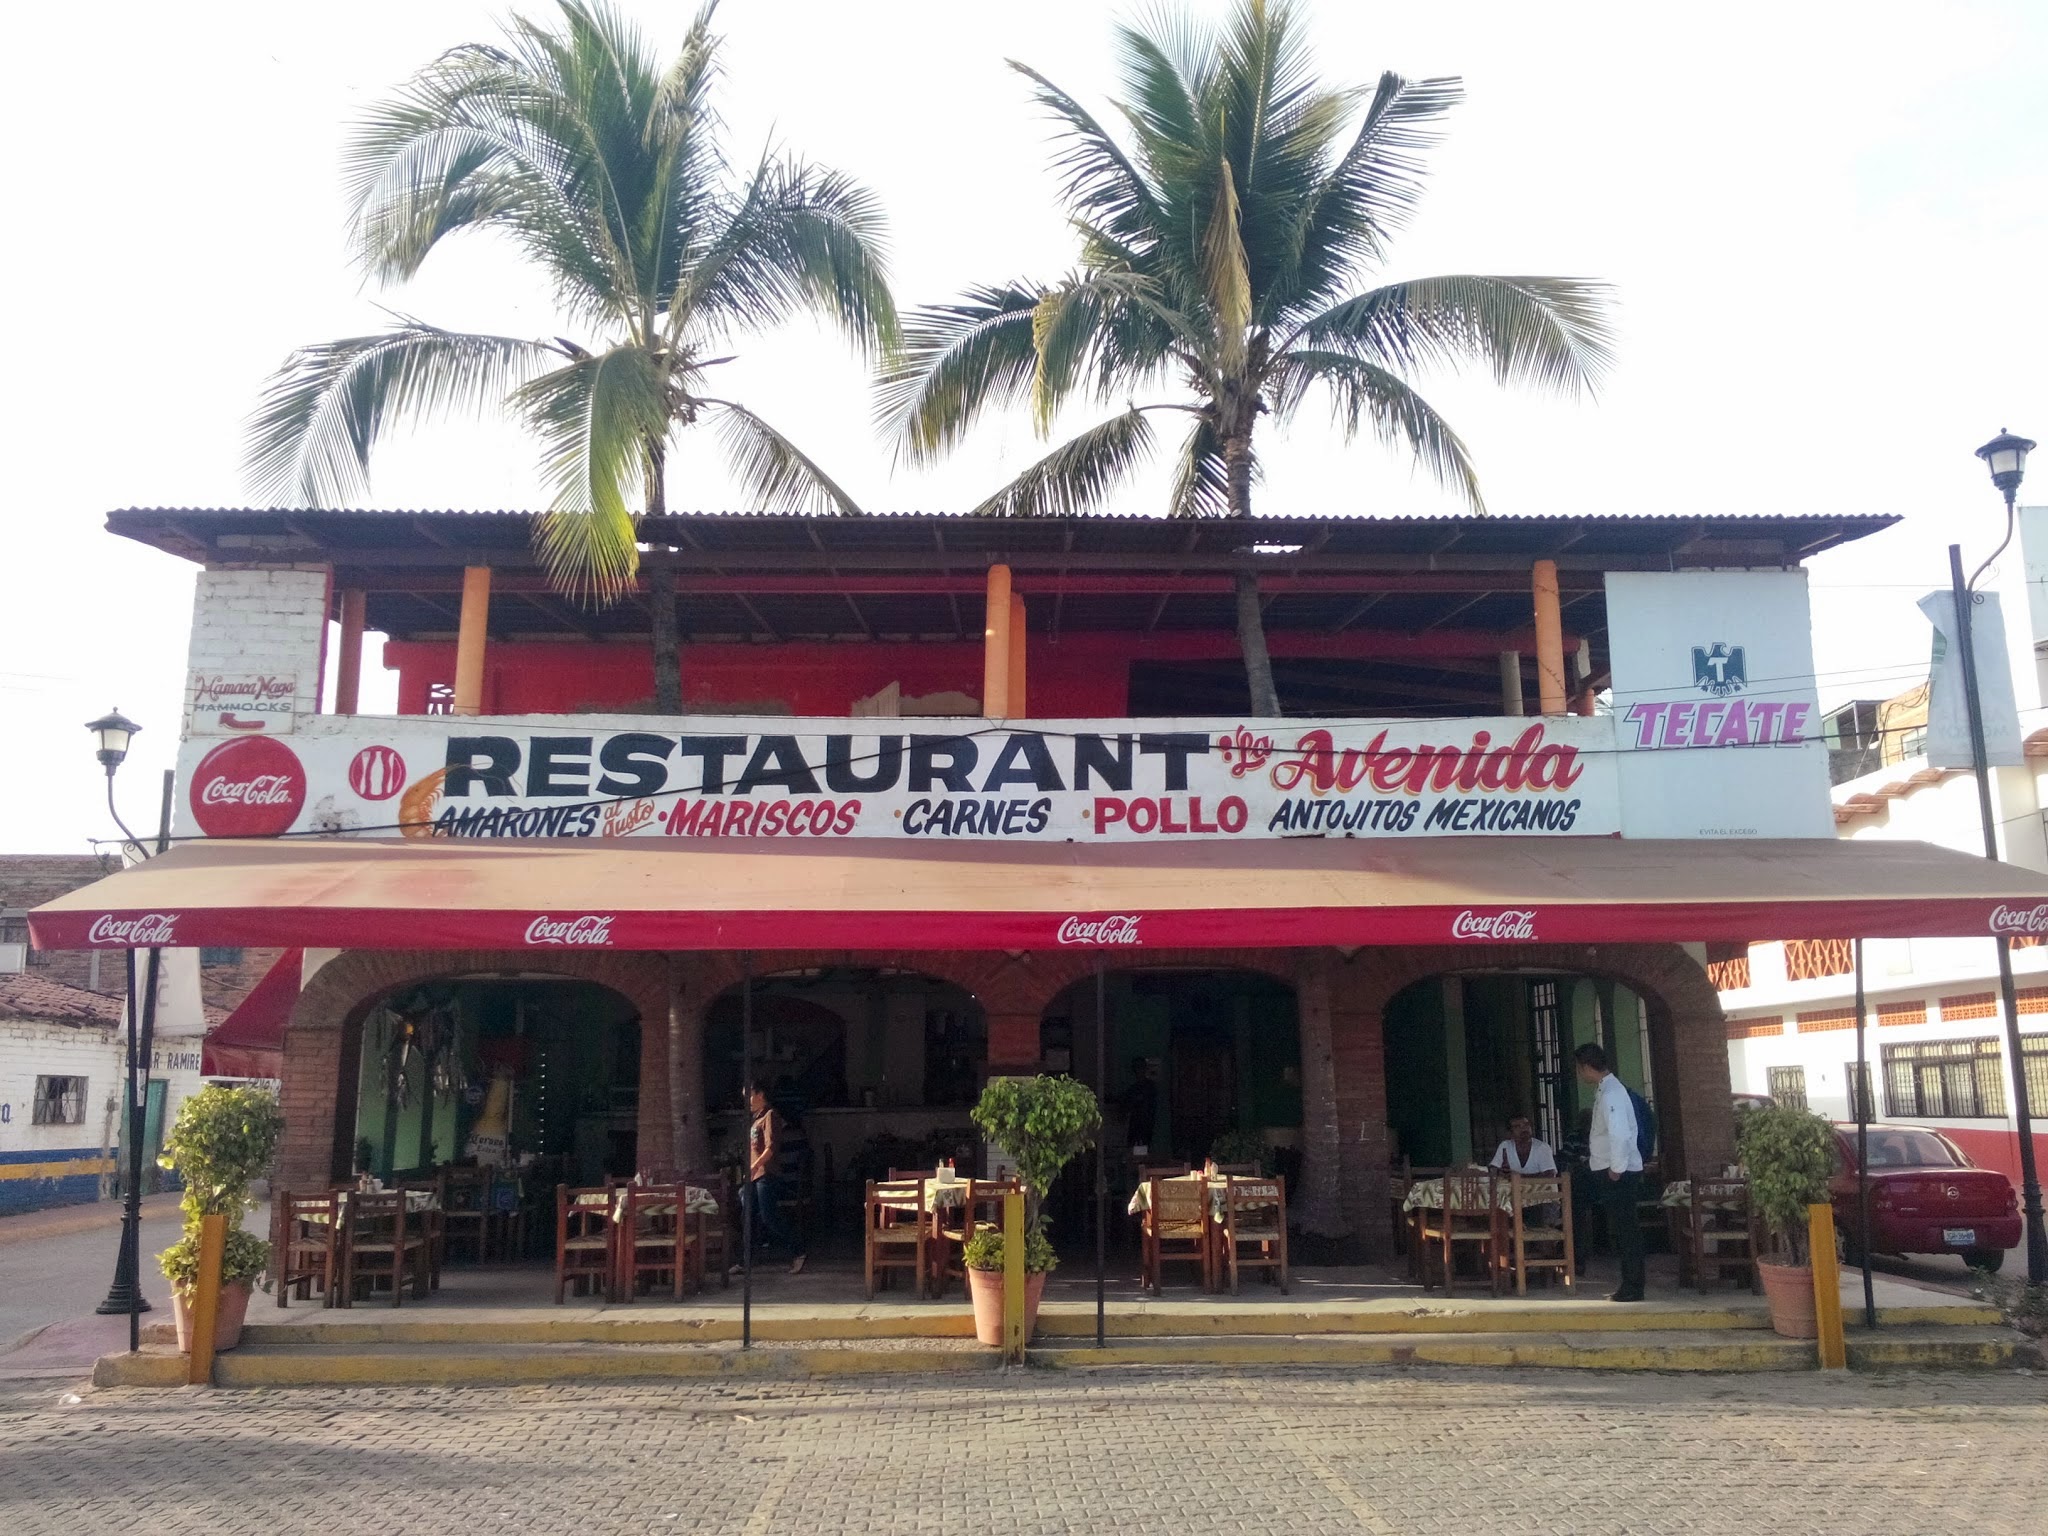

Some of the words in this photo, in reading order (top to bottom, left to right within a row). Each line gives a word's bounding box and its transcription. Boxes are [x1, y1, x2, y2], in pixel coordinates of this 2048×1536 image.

[194, 702, 292, 712] HAMMOCKS
[1624, 699, 1811, 749] TECATE
[443, 732, 1210, 797] RESTAURANT
[1231, 724, 1274, 777] La
[1270, 722, 1585, 795] Avenida
[202, 774, 292, 805] Coca-Cola
[664, 798, 862, 837] MARISCOS
[902, 797, 1052, 836] CARNES
[1094, 795, 1249, 835] POLLO
[1268, 798, 1421, 832] ANTOJITOS
[1423, 798, 1582, 832] MEXICANOS
[88, 914, 181, 944] Coca-Cola
[524, 915, 616, 945] Coca-Cola
[1057, 915, 1143, 944] Coca-Cola
[1452, 910, 1538, 939] Coca-Cola
[1988, 904, 2048, 932] Coca-Co
[167, 1052, 200, 1070] RAMIRE
